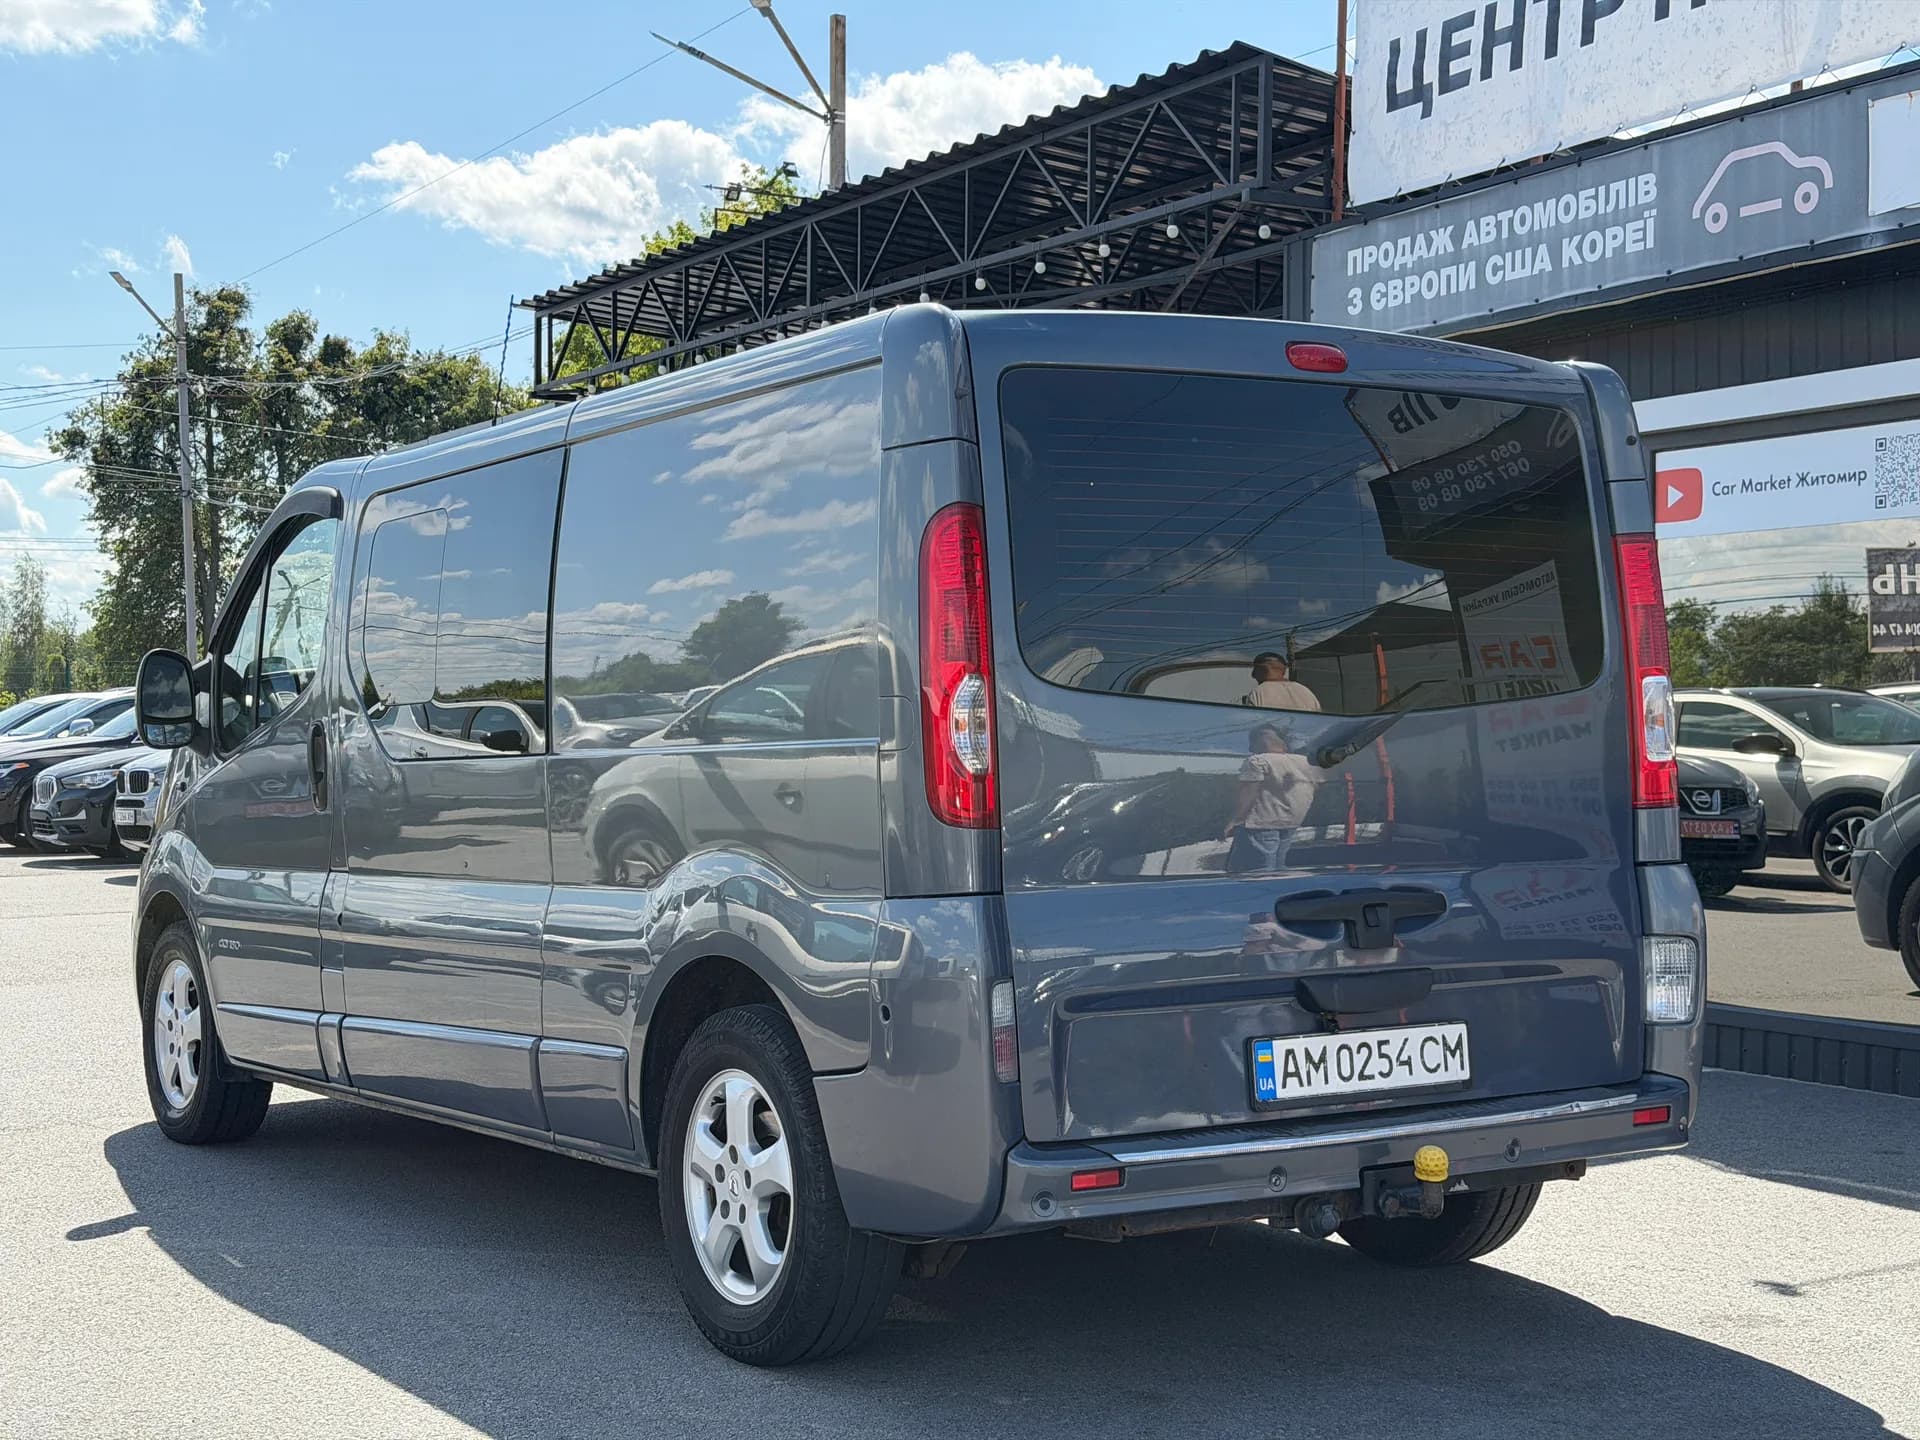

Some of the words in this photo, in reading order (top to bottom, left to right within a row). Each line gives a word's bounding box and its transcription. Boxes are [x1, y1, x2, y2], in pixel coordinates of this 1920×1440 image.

[1347, 225, 1455, 276] ПРОДАЖ
[1461, 172, 1657, 249] АВТОМОБІЛІВ
[1347, 287, 1363, 316] З
[1370, 260, 1476, 311] ЄВРОПИ
[1485, 243, 1552, 285] США
[1562, 208, 1657, 269] КОРЕЇ
[1712, 481, 1737, 497] Car
[1740, 474, 1792, 494] Market
[1795, 469, 1868, 489] Житомир
[1259, 1078, 1275, 1091] UA
[1281, 1045, 1329, 1089] AM
[1336, 1037, 1413, 1082] 0254
[1419, 1032, 1465, 1074] CM
